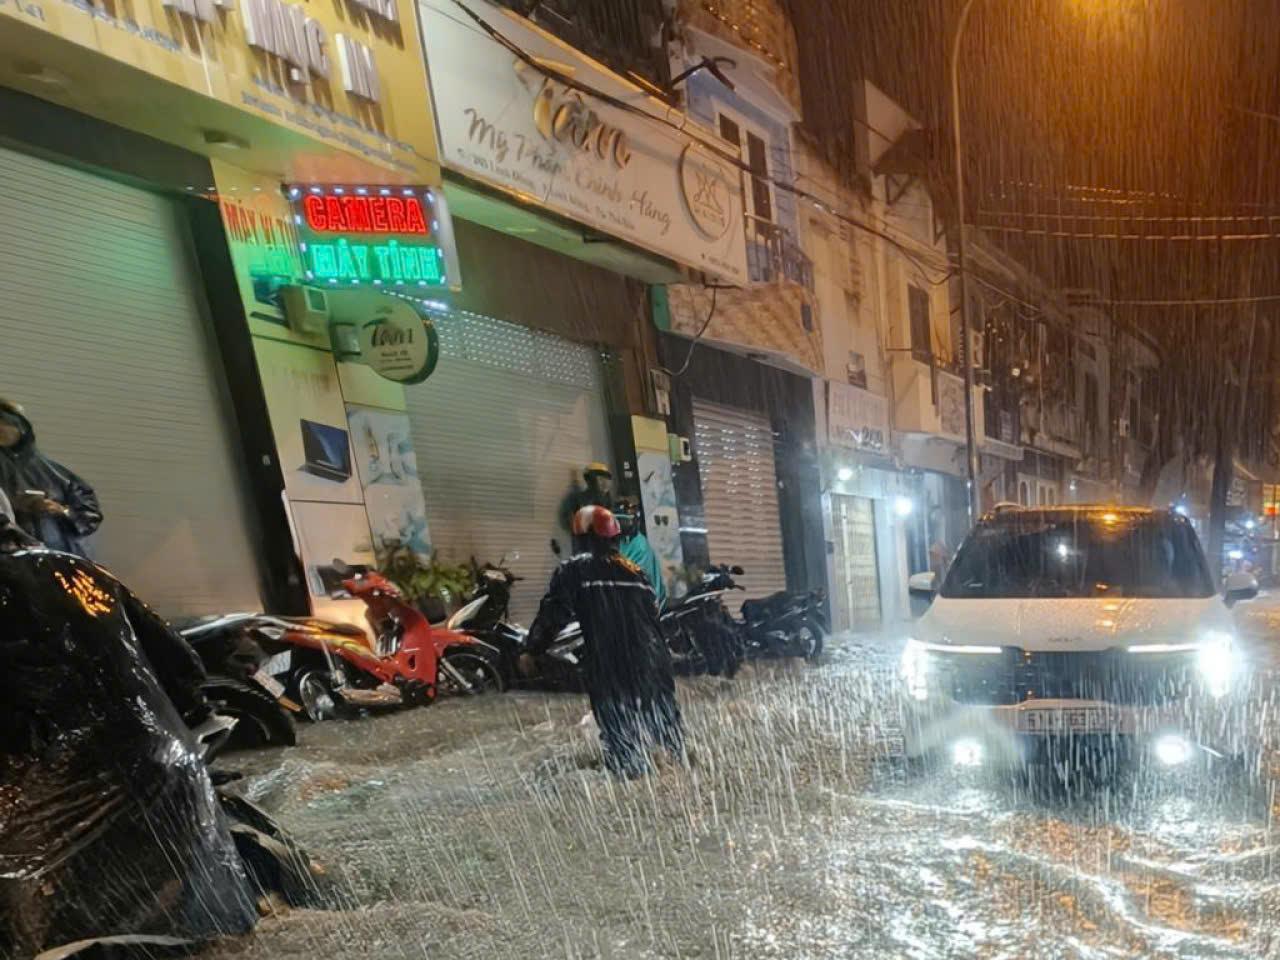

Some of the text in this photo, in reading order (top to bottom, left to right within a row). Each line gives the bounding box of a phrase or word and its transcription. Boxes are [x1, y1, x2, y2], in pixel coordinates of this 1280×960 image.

[305, 195, 428, 234] CAMERA
[310, 238, 440, 279] MÁY TÍNH
